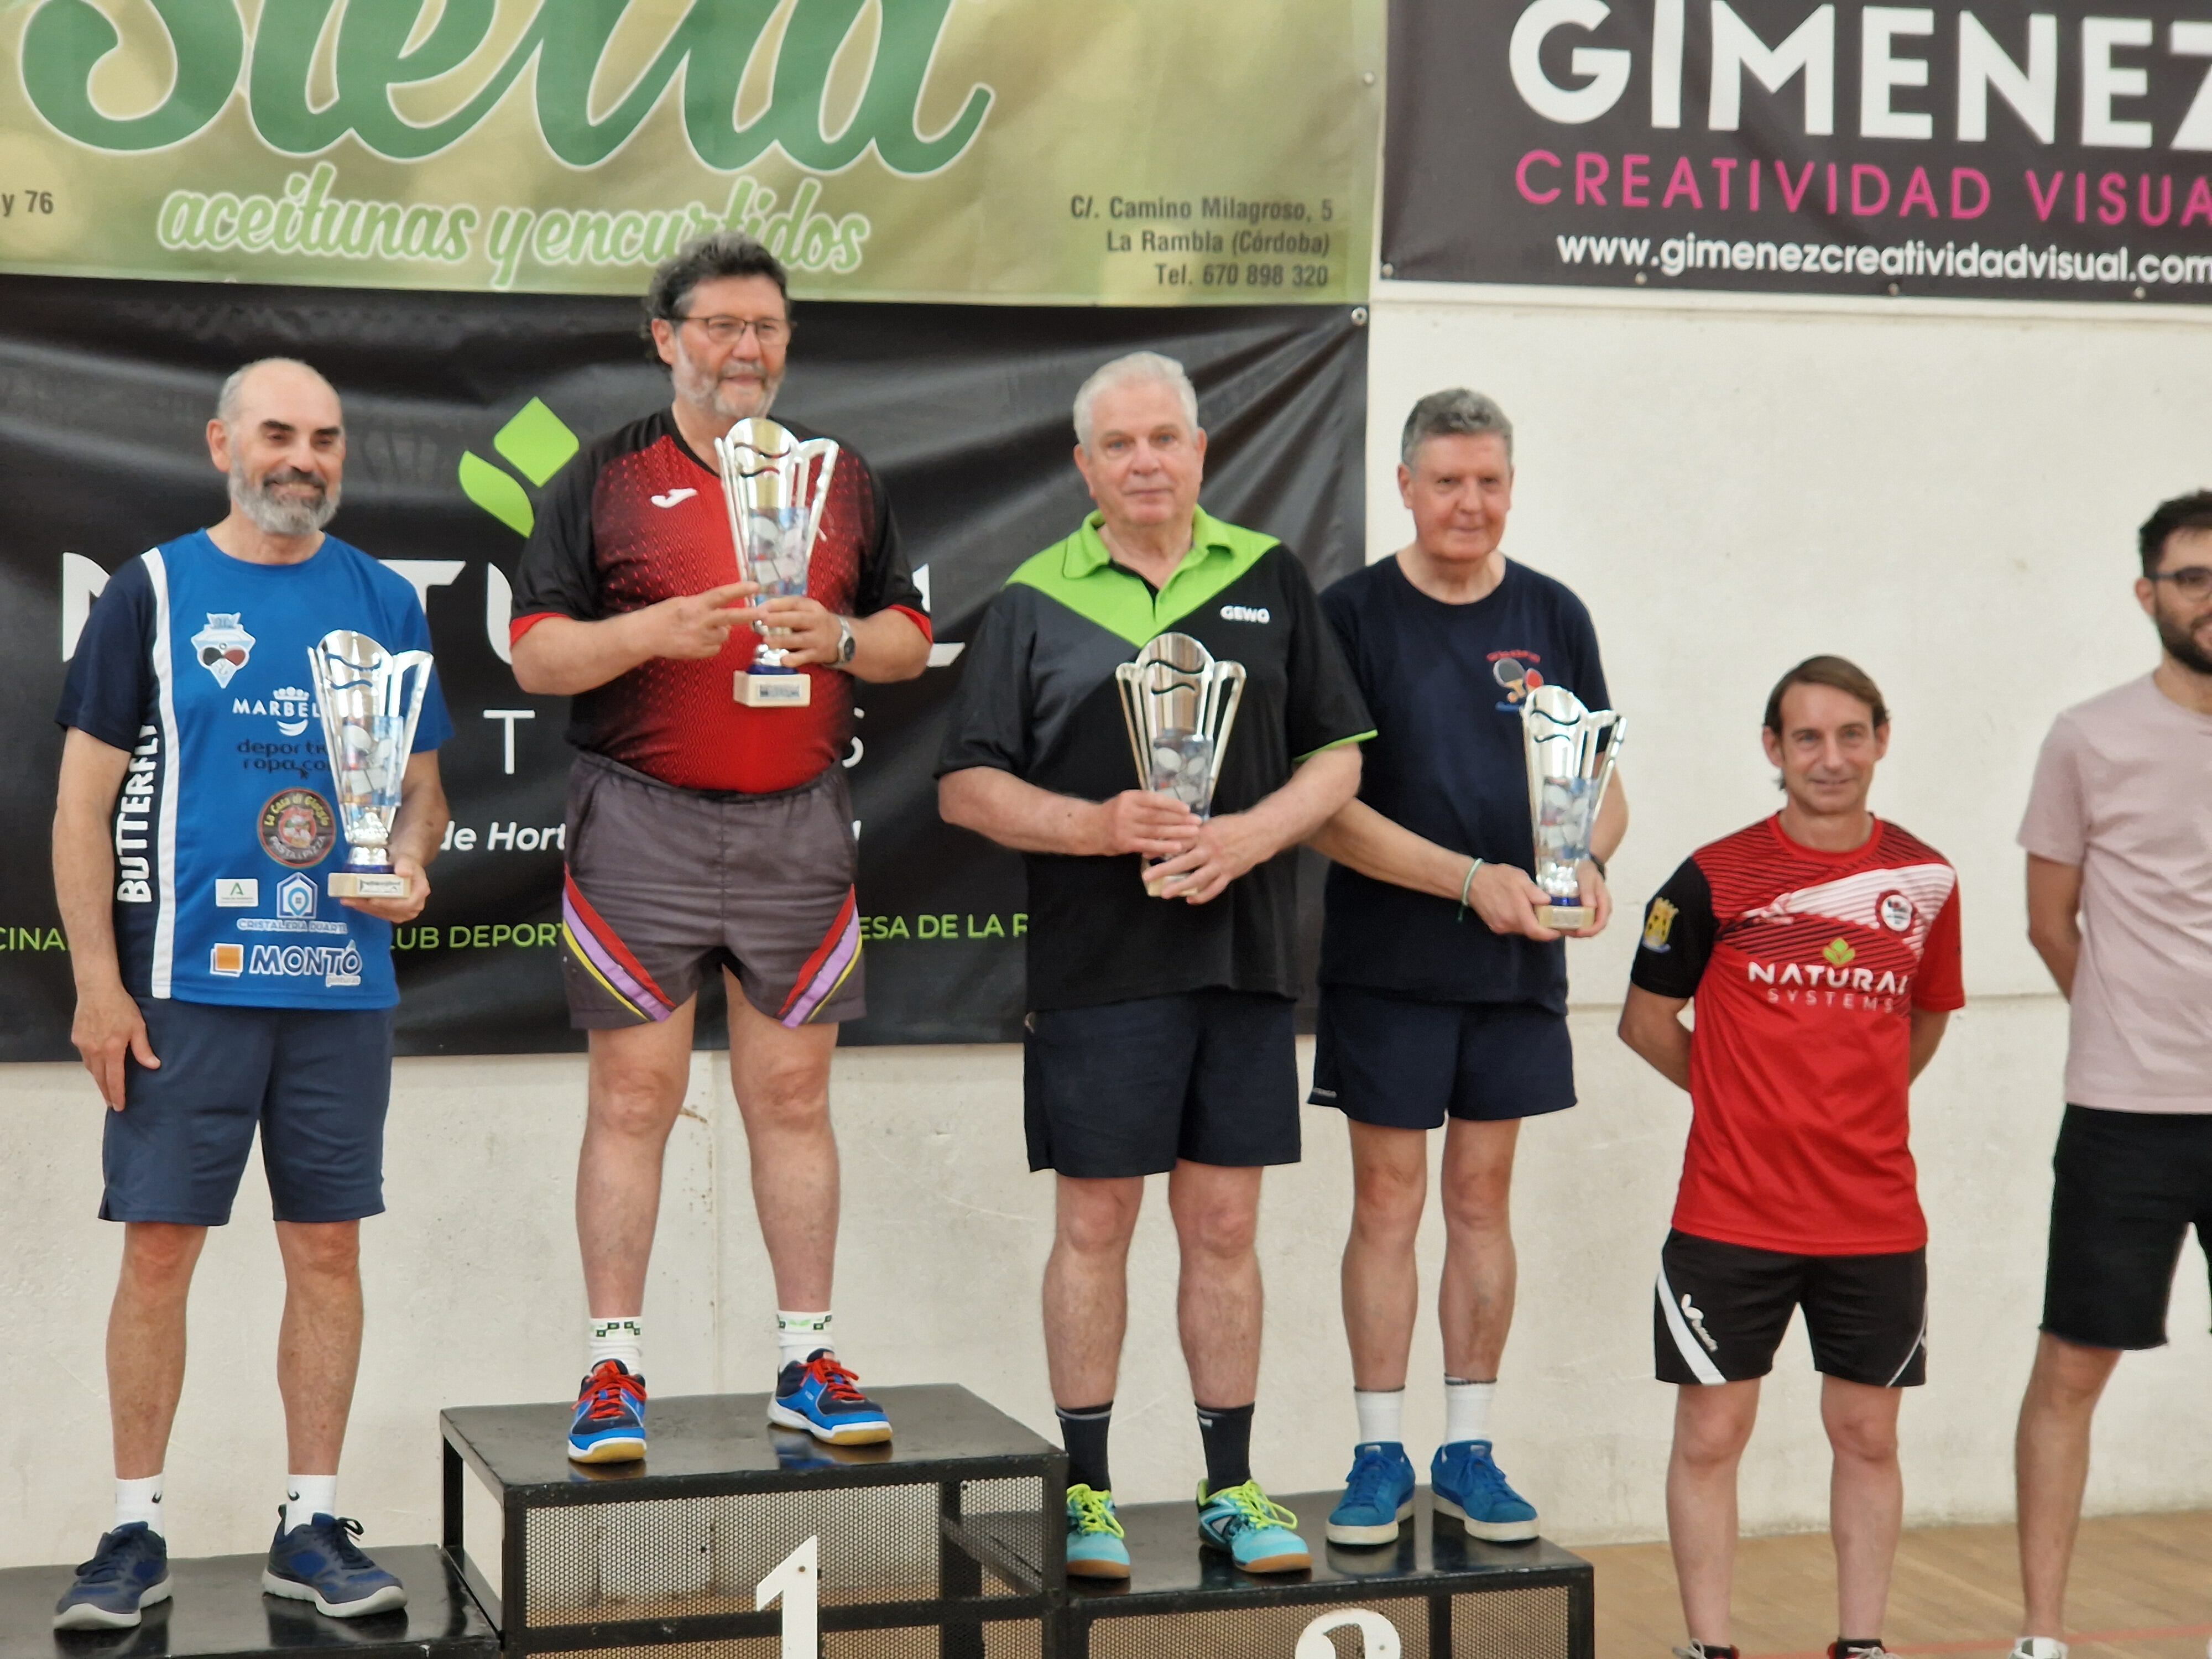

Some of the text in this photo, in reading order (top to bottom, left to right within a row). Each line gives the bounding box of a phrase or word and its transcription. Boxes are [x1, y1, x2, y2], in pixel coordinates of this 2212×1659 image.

[1516, 150, 1991, 219] CREATIVIDAD
[2, 189, 54, 217] y 76
[1071, 195, 1332, 225] C/. Camino Milagroso, 5
[158, 161, 870, 291] aceitunas y encurtidos
[1107, 229, 1329, 258] La Rambla (Córdoba)
[1557, 232, 2212, 284] www.gimenezcreatividadvisual.com
[1156, 263, 1328, 286] Tel. 670 898 320
[449, 923, 562, 948] DEPOR
[918, 914, 958, 938] DE
[968, 914, 1005, 938] LA
